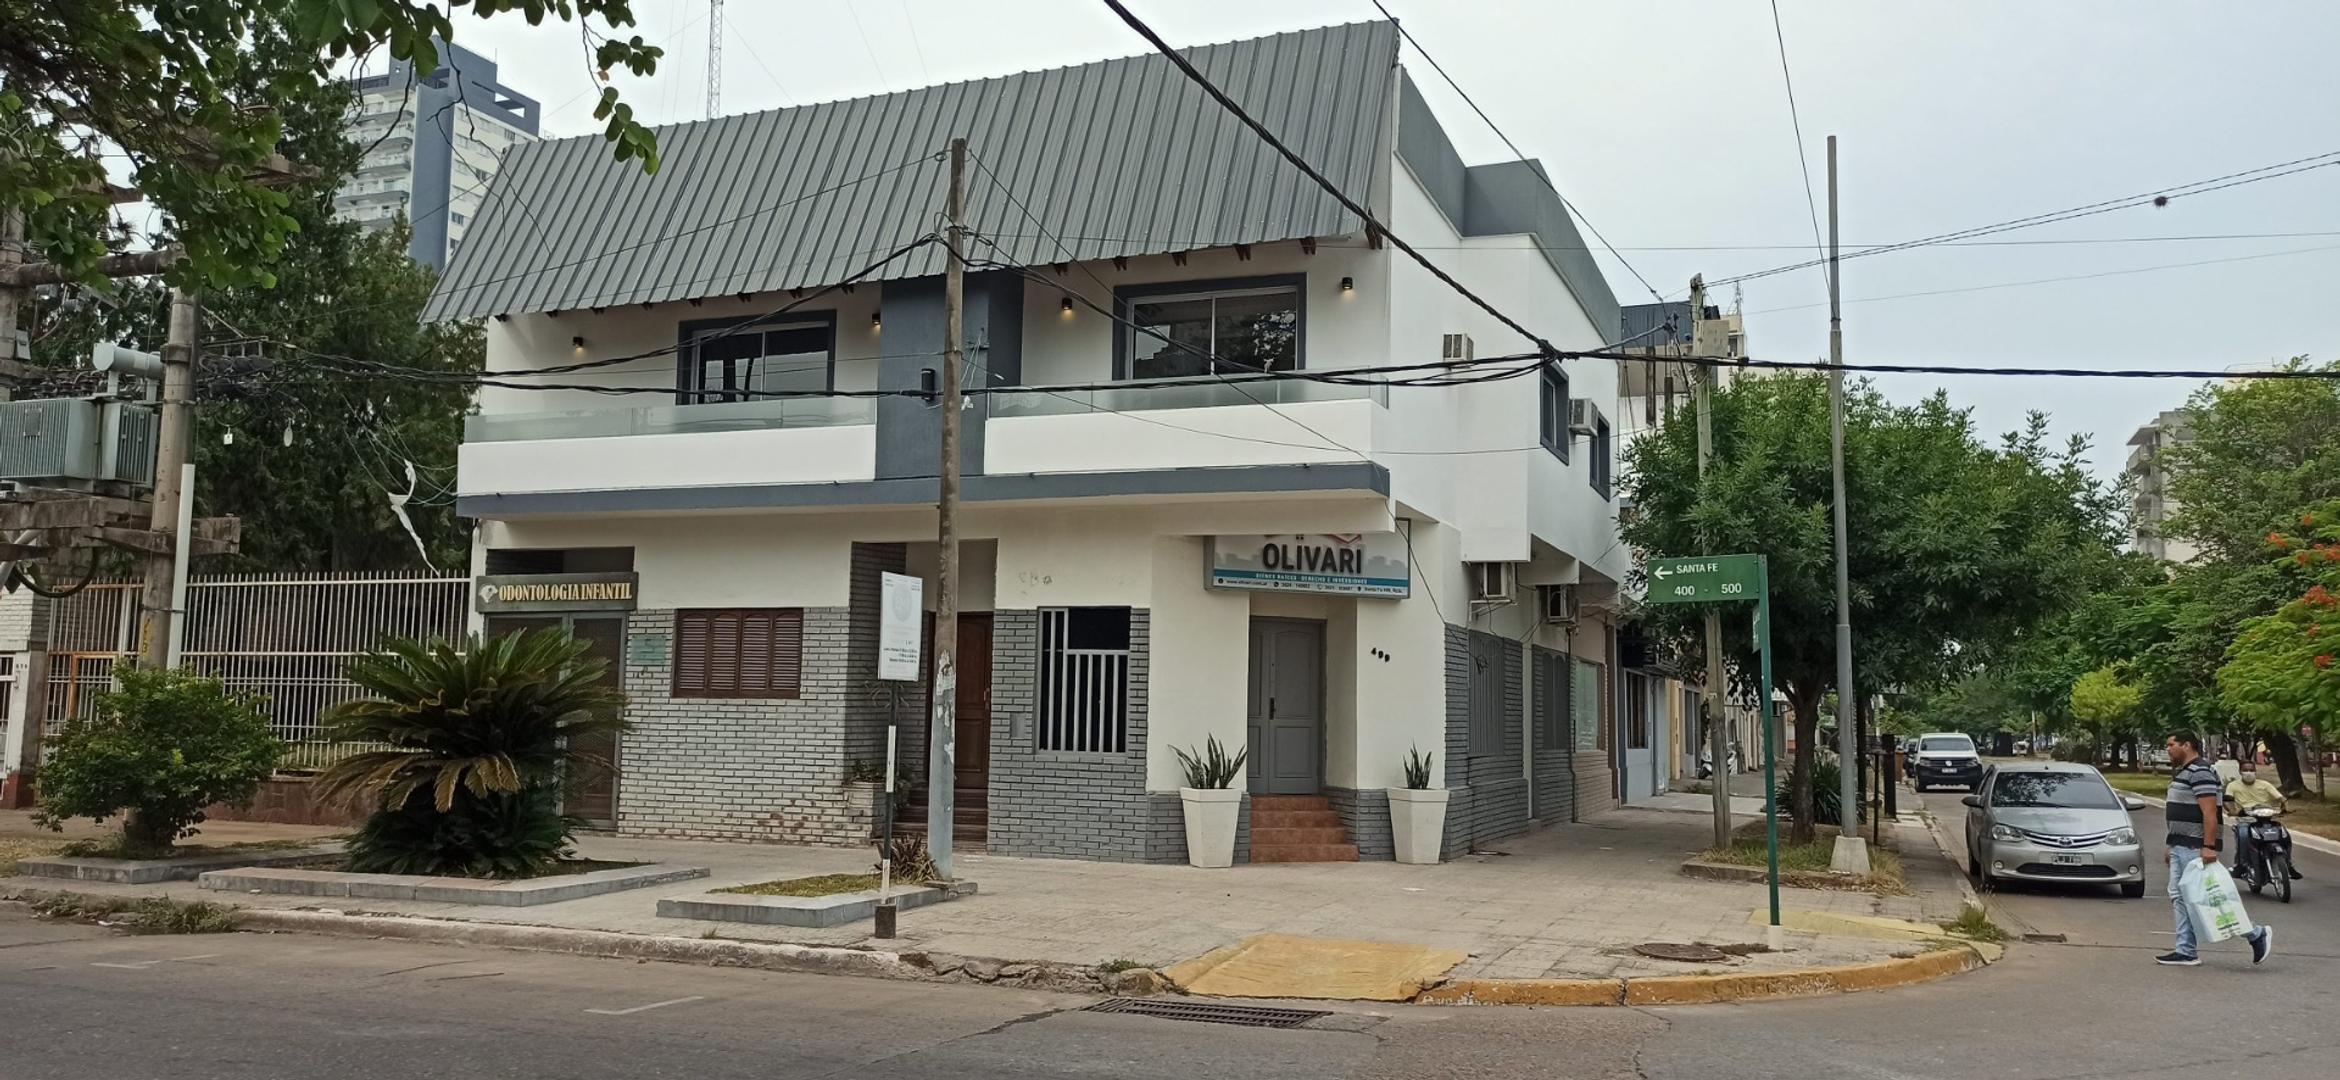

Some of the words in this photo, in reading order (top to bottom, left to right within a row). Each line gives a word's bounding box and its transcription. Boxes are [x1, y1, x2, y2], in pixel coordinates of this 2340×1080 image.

[1262, 543, 1362, 574] OLIVARI
[1676, 564, 1706, 574] SANTA
[1707, 563, 1718, 572] FE
[498, 583, 580, 601] ODONTOLOGIA
[581, 582, 633, 600] INFANTIL
[1674, 585, 1695, 596] 400
[1721, 583, 1742, 594] 500
